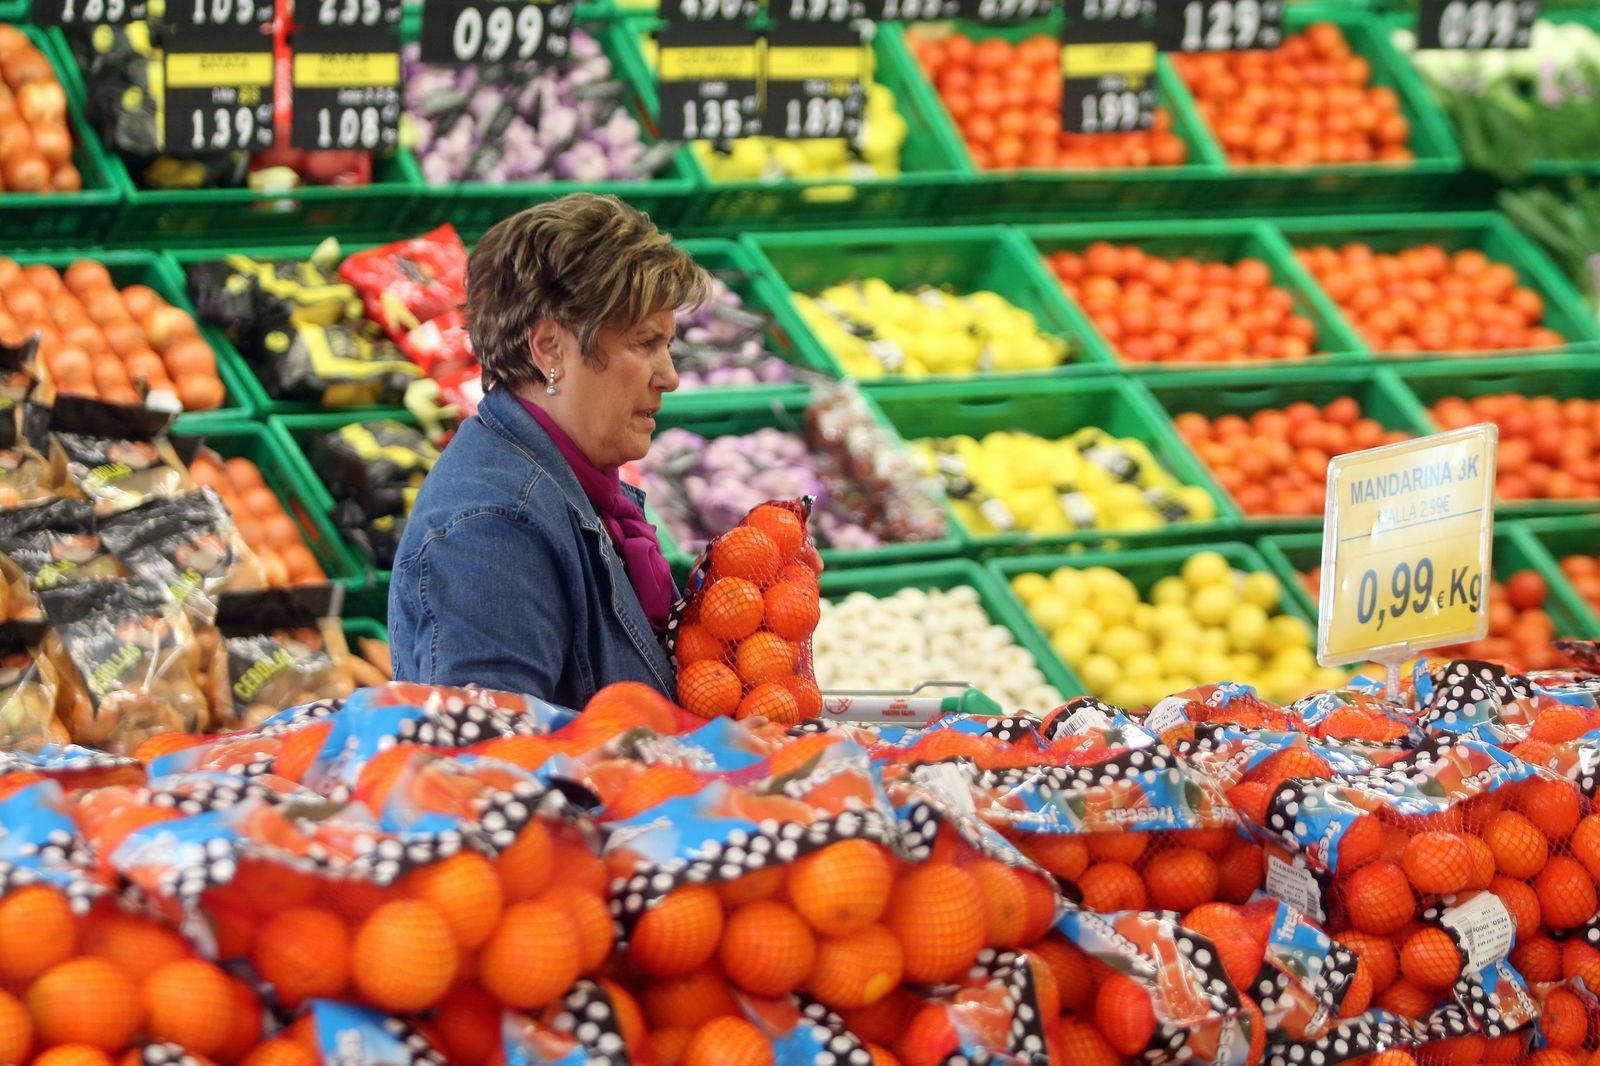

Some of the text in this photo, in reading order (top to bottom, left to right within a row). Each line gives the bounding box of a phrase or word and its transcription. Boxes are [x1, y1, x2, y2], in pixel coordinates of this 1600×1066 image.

[1350, 454, 1480, 505] MANDARINA 3K
[1357, 557, 1434, 631] 0,99
[1450, 565, 1482, 613] Kg
